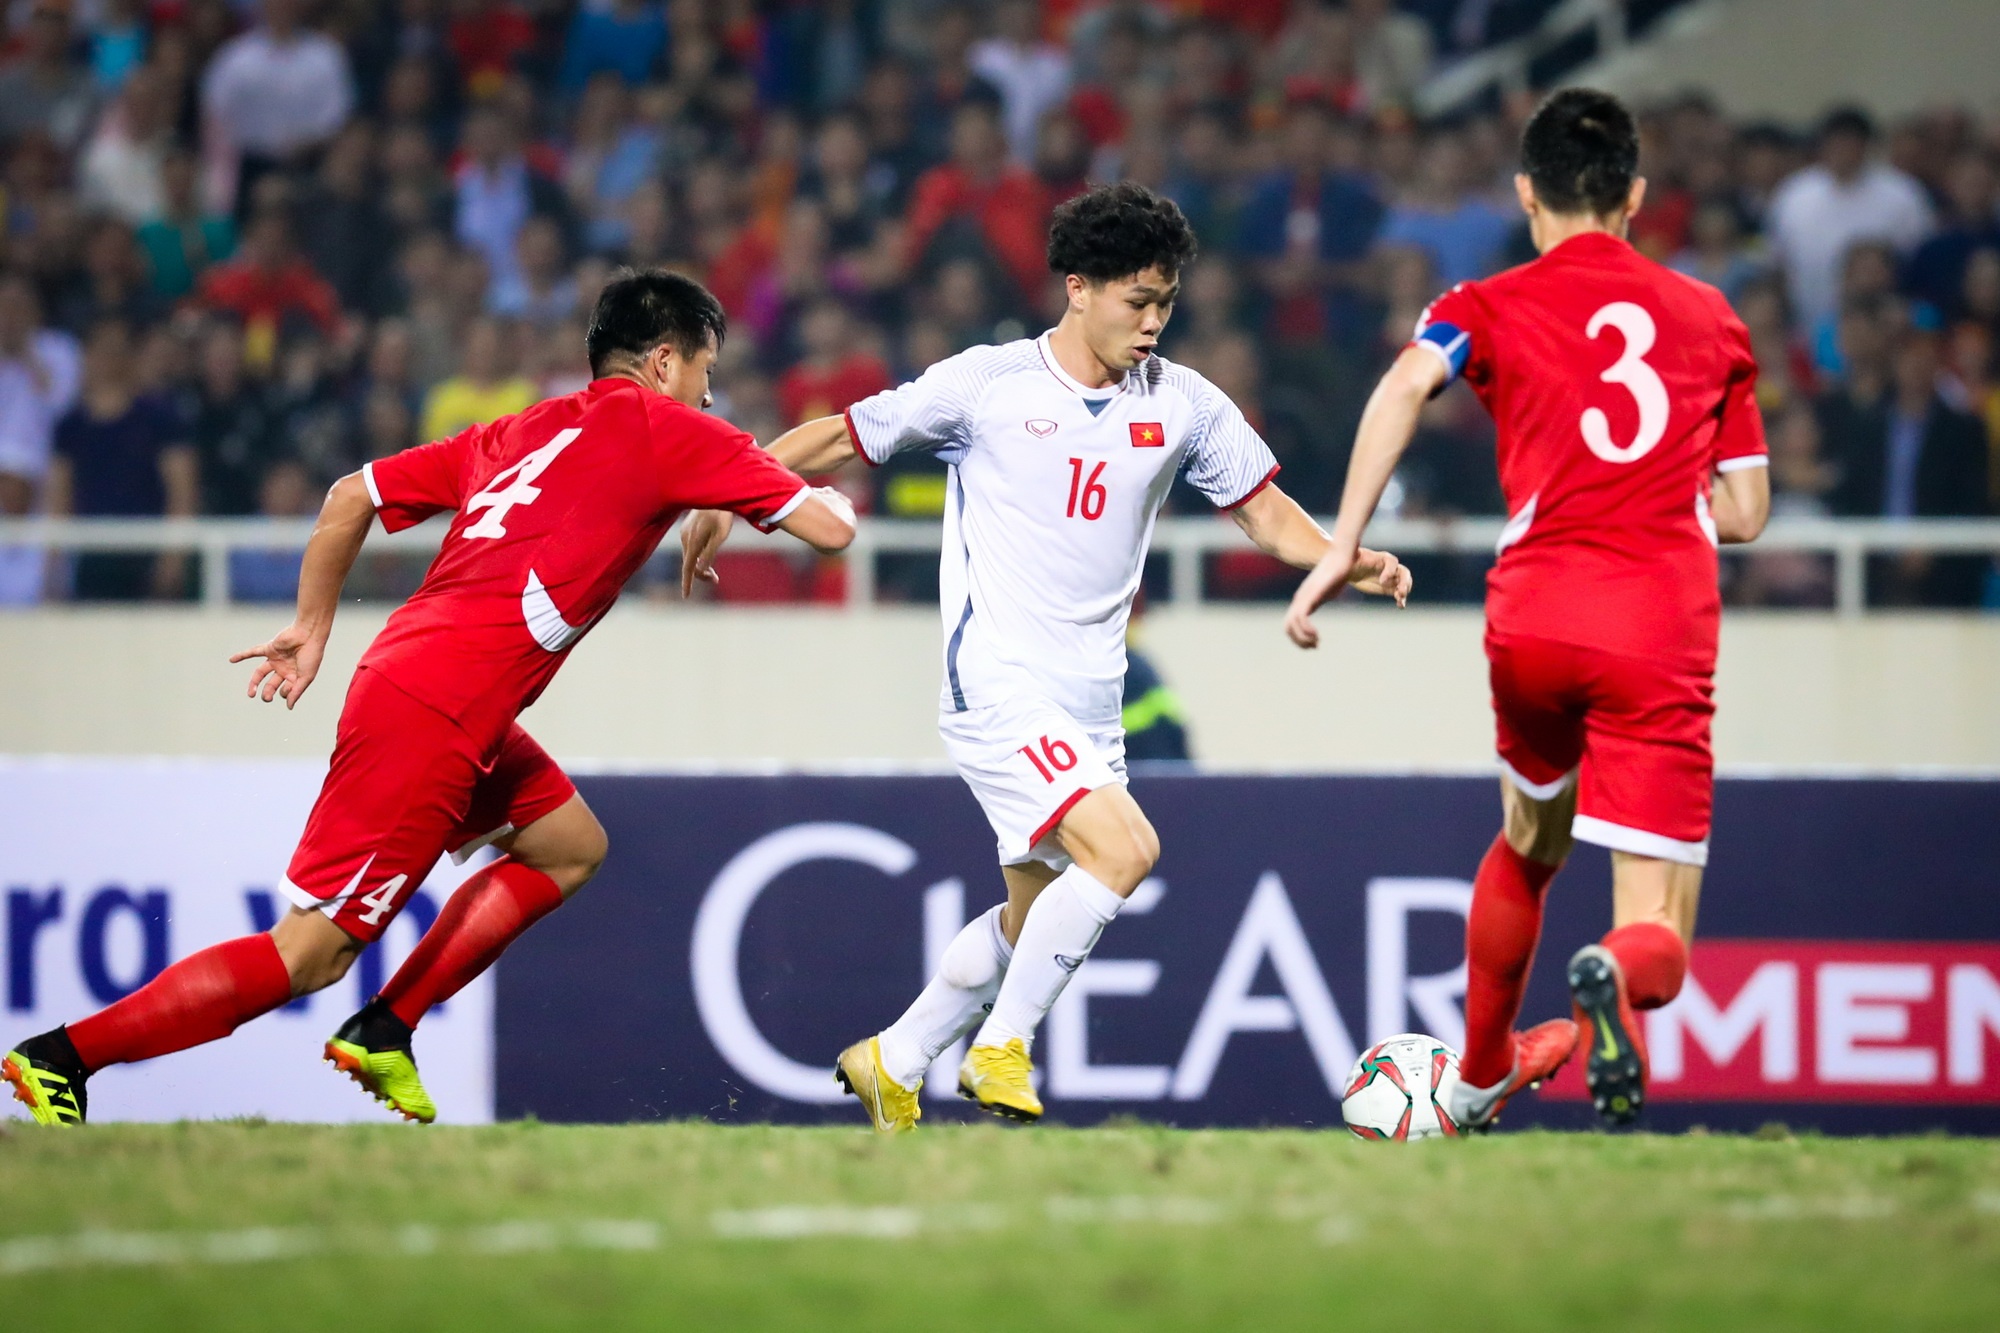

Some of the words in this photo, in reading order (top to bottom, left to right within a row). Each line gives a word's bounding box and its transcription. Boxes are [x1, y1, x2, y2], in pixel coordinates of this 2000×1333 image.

[1579, 300, 1671, 465] 3
[461, 426, 584, 540] 4
[1065, 456, 1108, 522] 16
[1016, 734, 1078, 785] 16
[356, 872, 409, 927] 4
